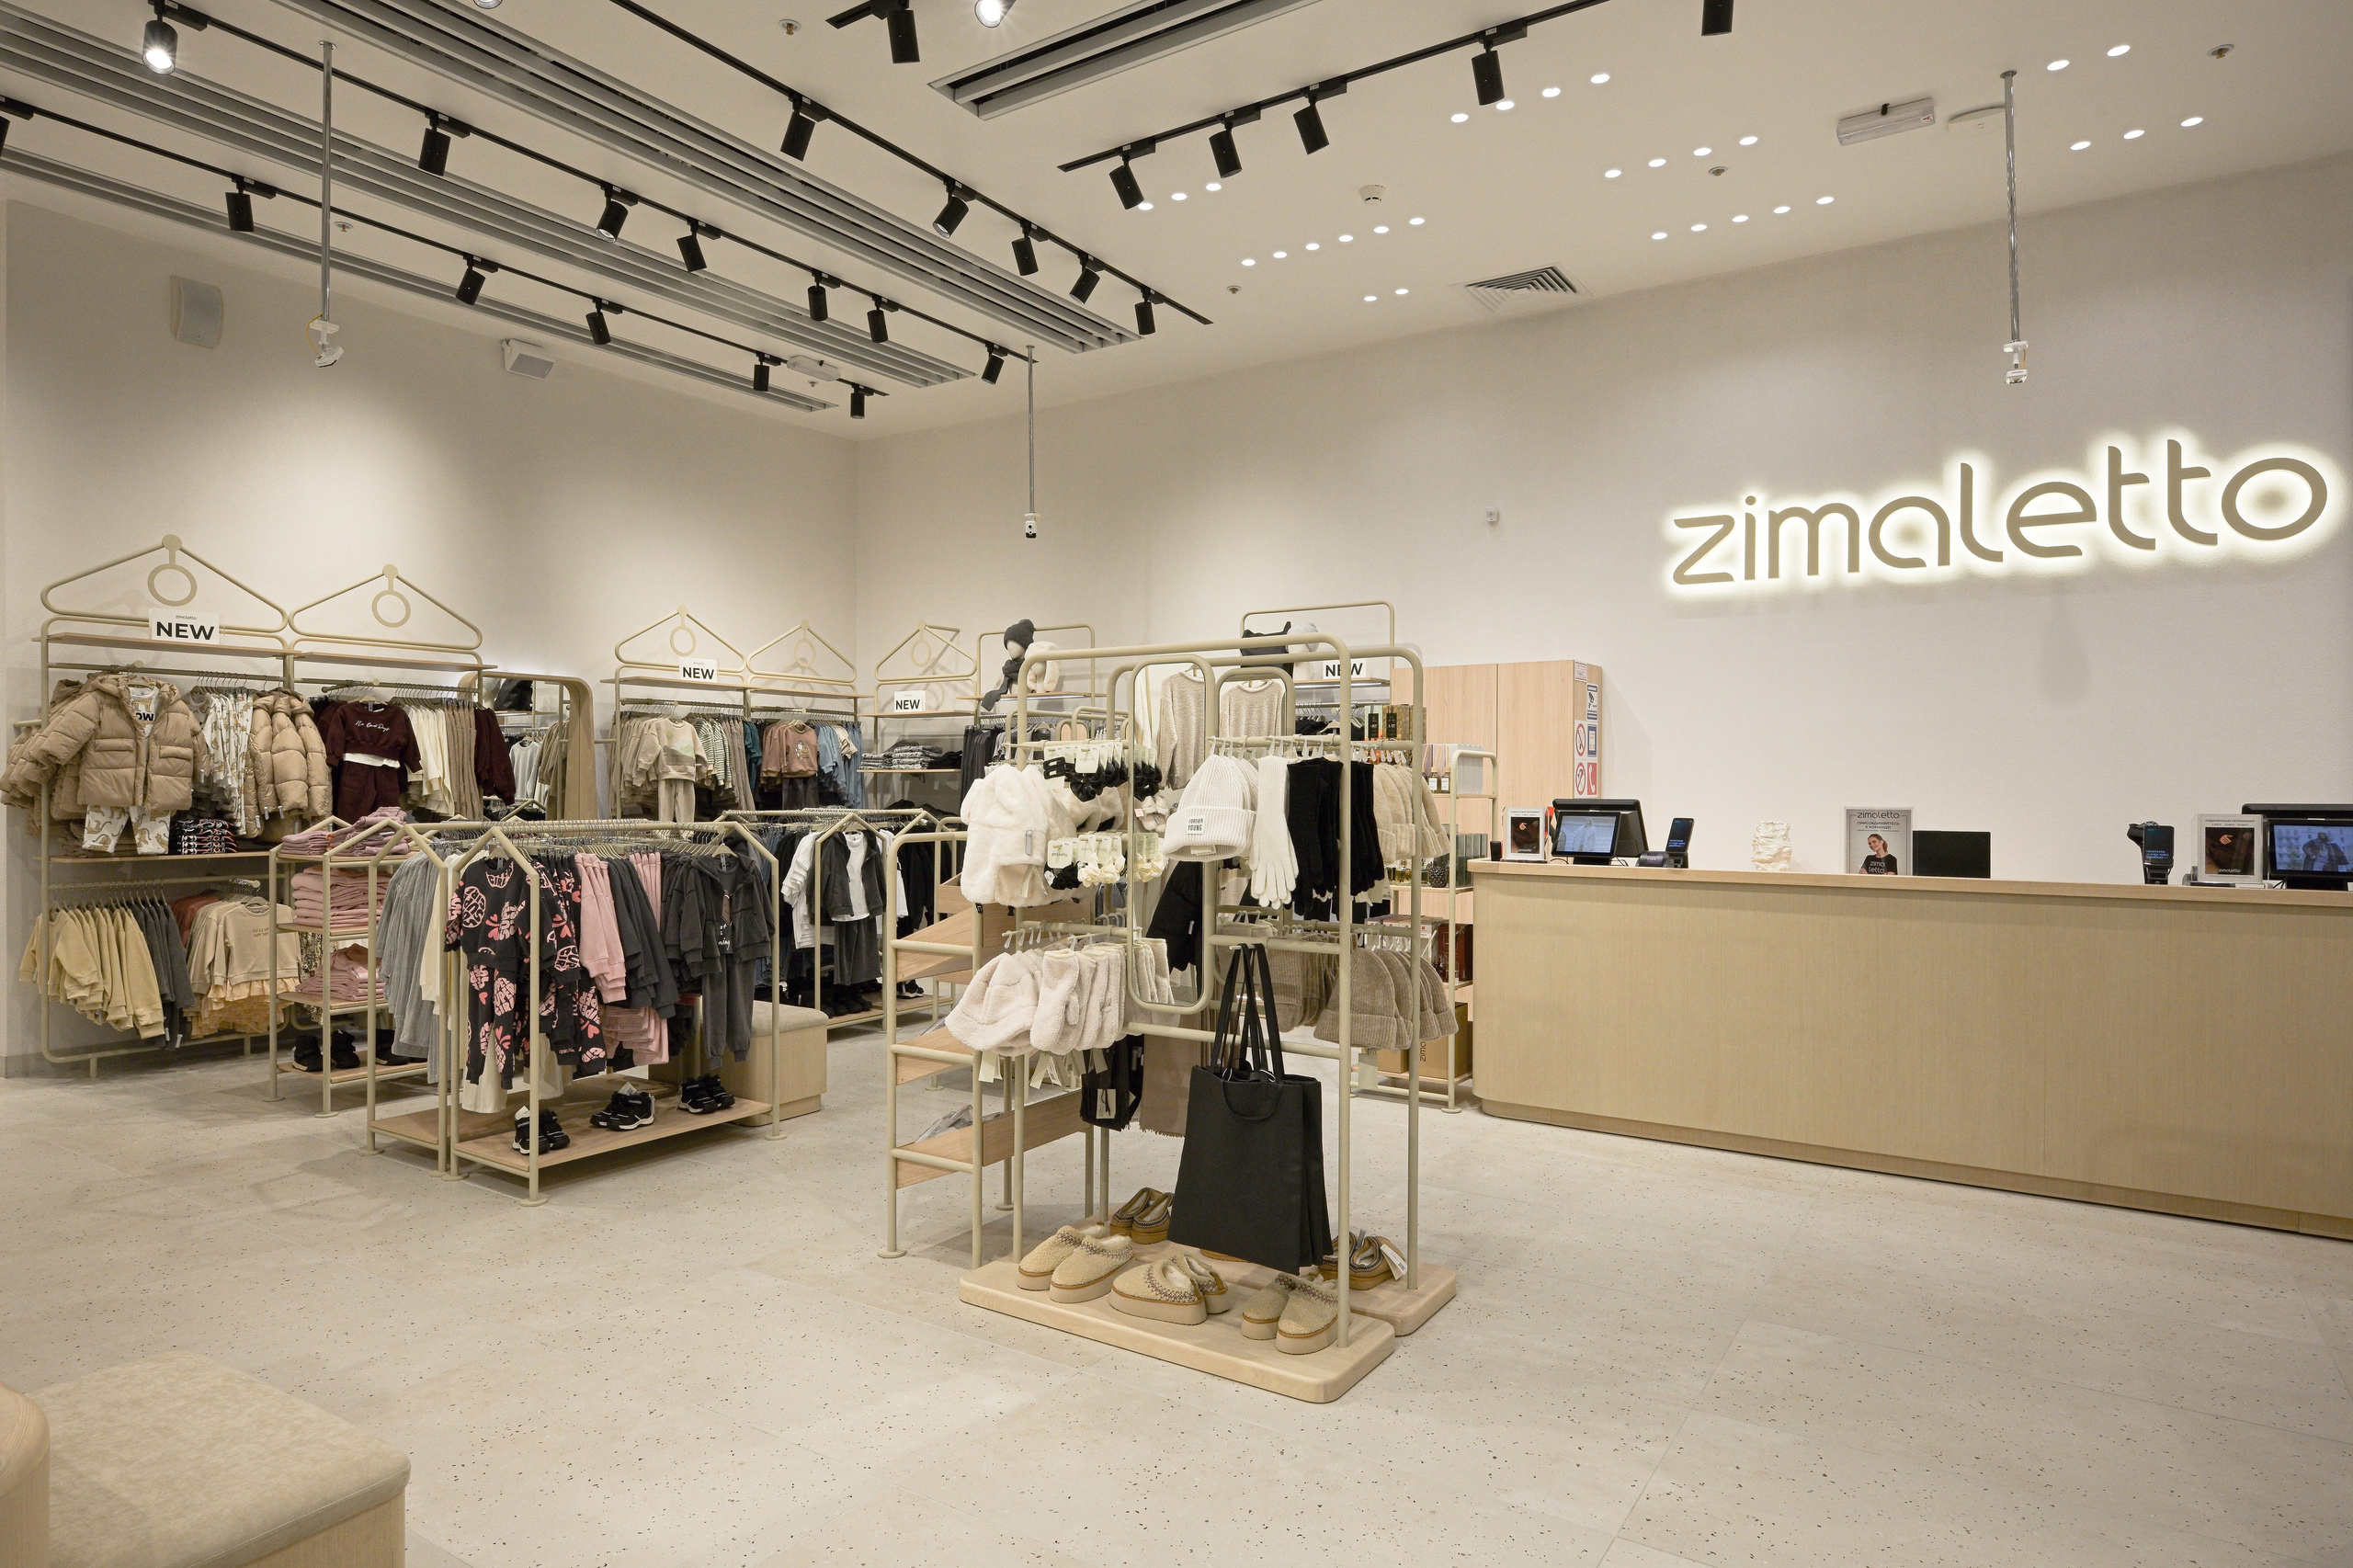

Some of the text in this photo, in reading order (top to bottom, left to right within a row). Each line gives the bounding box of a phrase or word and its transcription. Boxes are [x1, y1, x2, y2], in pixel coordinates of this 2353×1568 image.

[1673, 438, 2328, 585] zimaletto
[156, 620, 215, 641] NEW
[682, 666, 715, 680] NEW
[895, 699, 921, 710] NEW
[1857, 811, 1900, 819] zimaletto
[1188, 824, 1202, 832] YOUNG
[1869, 866, 1885, 874] letto
